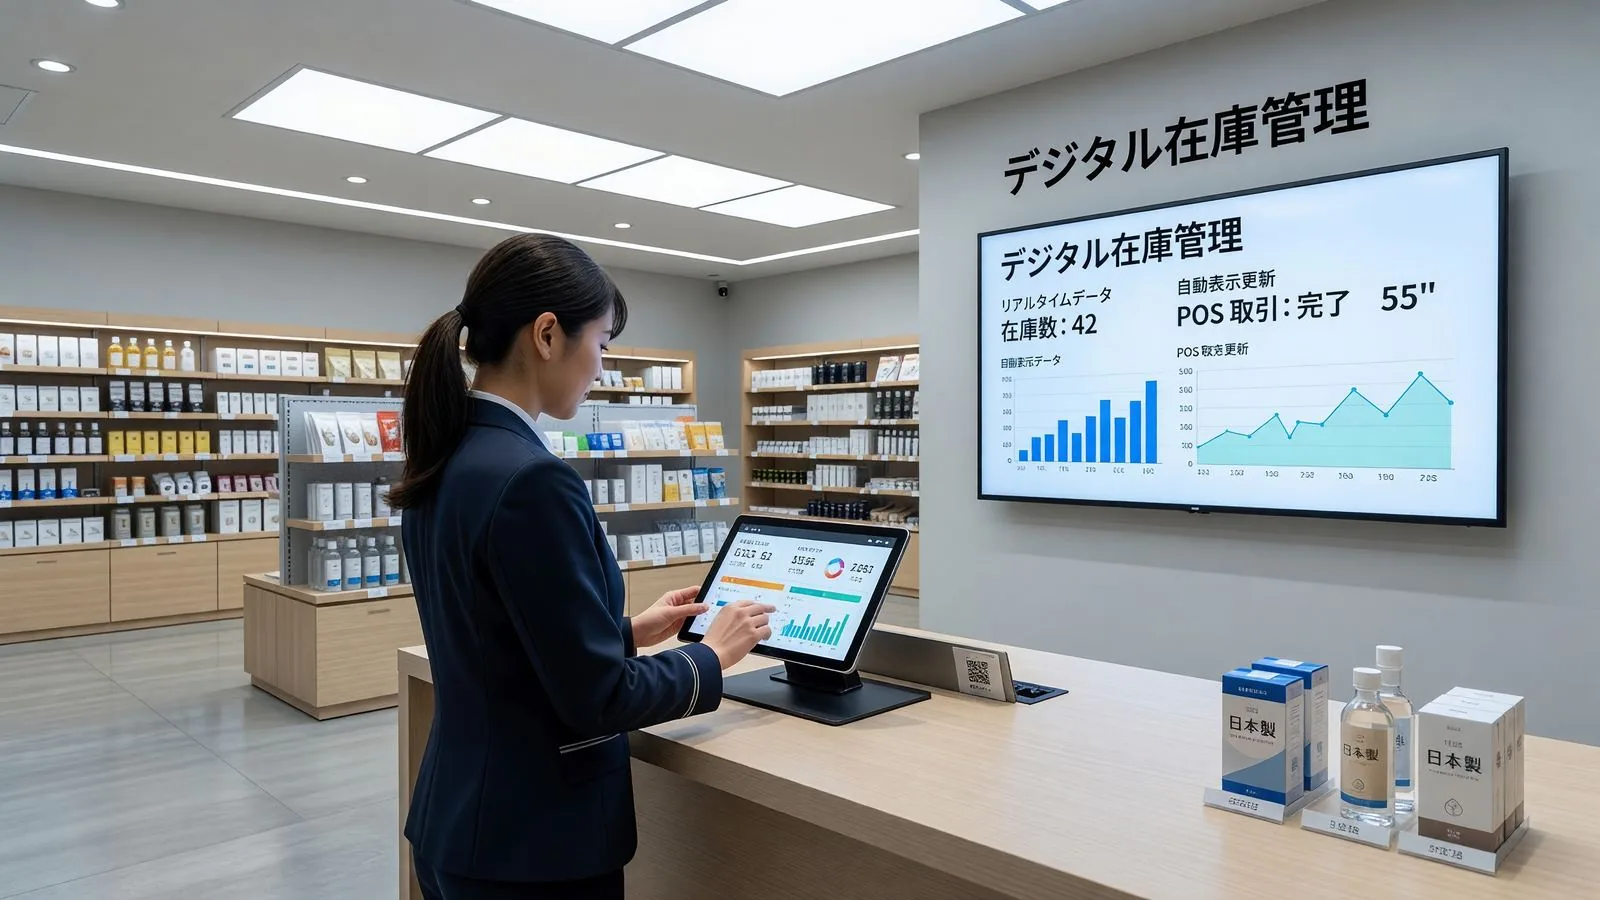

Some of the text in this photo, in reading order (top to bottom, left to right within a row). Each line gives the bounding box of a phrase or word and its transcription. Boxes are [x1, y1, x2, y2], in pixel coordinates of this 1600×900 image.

[1003, 78, 1369, 196] デジタル在庫管理
[1001, 216, 1243, 281] デジタル在庫管理
[1177, 269, 1276, 297] 自動表示更新
[1001, 287, 1112, 312] リアルタイムデータ
[1177, 303, 1223, 327] POS
[1001, 314, 1097, 342] 在庫数：42
[1177, 347, 1199, 358] POS
[1229, 715, 1277, 739] 日本製
[1427, 749, 1482, 774] 日本製
